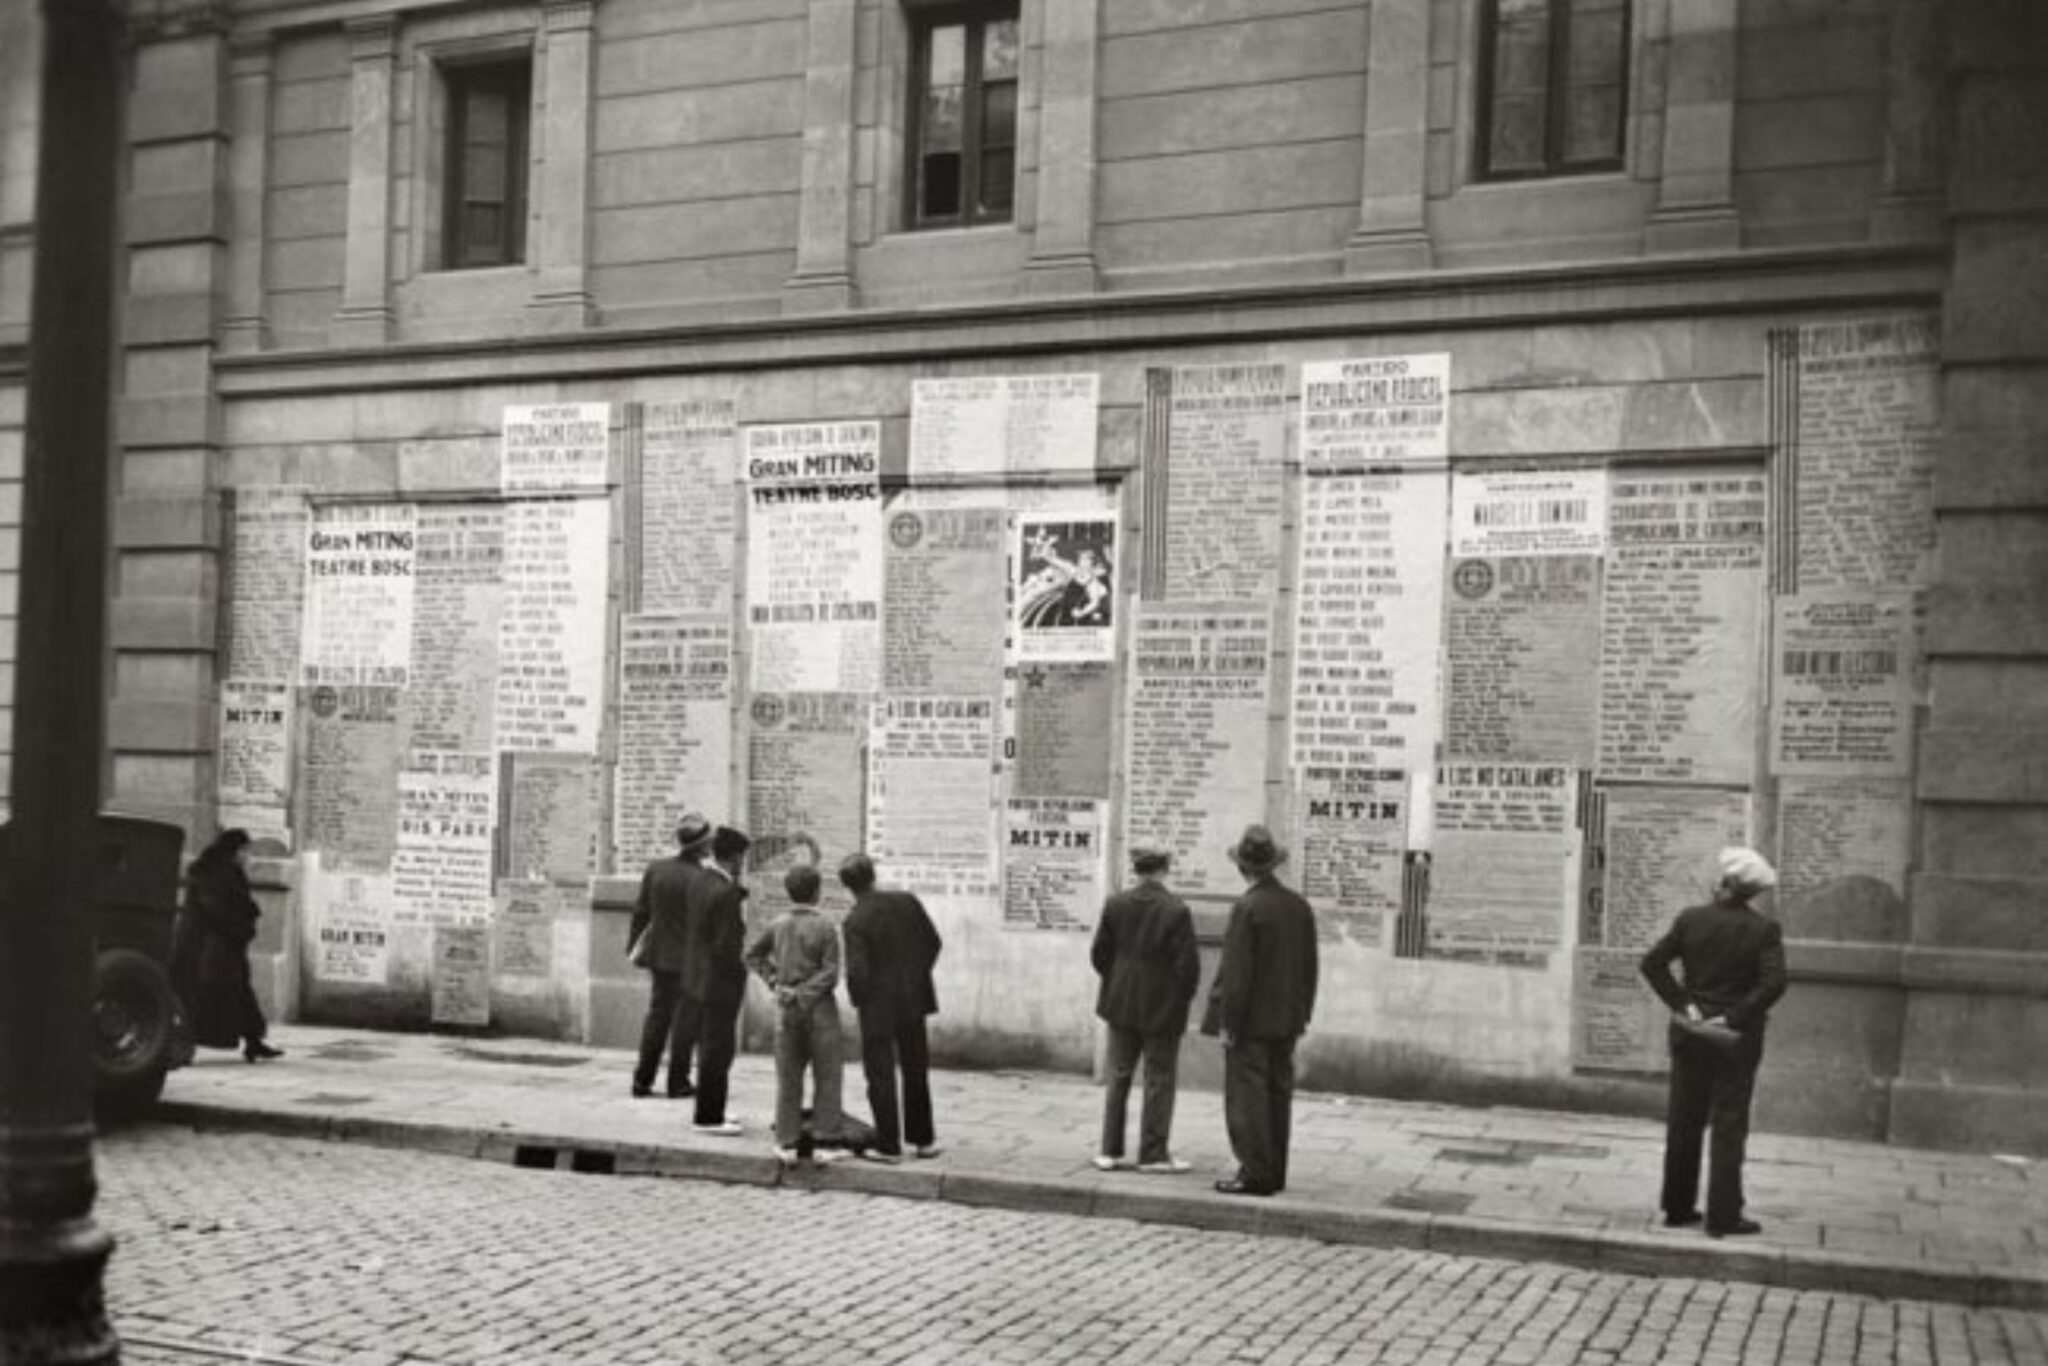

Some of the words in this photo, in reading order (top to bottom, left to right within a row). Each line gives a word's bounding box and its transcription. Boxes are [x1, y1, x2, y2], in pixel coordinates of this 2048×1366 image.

[803, 452, 875, 476] MITING
[751, 485, 821, 504] TEATRE
[826, 483, 877, 502] BOSC
[355, 530, 413, 551] MITING
[310, 559, 366, 577] TEATRE
[371, 559, 412, 577] BOSC
[226, 708, 284, 724] MITIN
[1309, 801, 1399, 820] MITIN
[1010, 829, 1091, 848] MITIN
